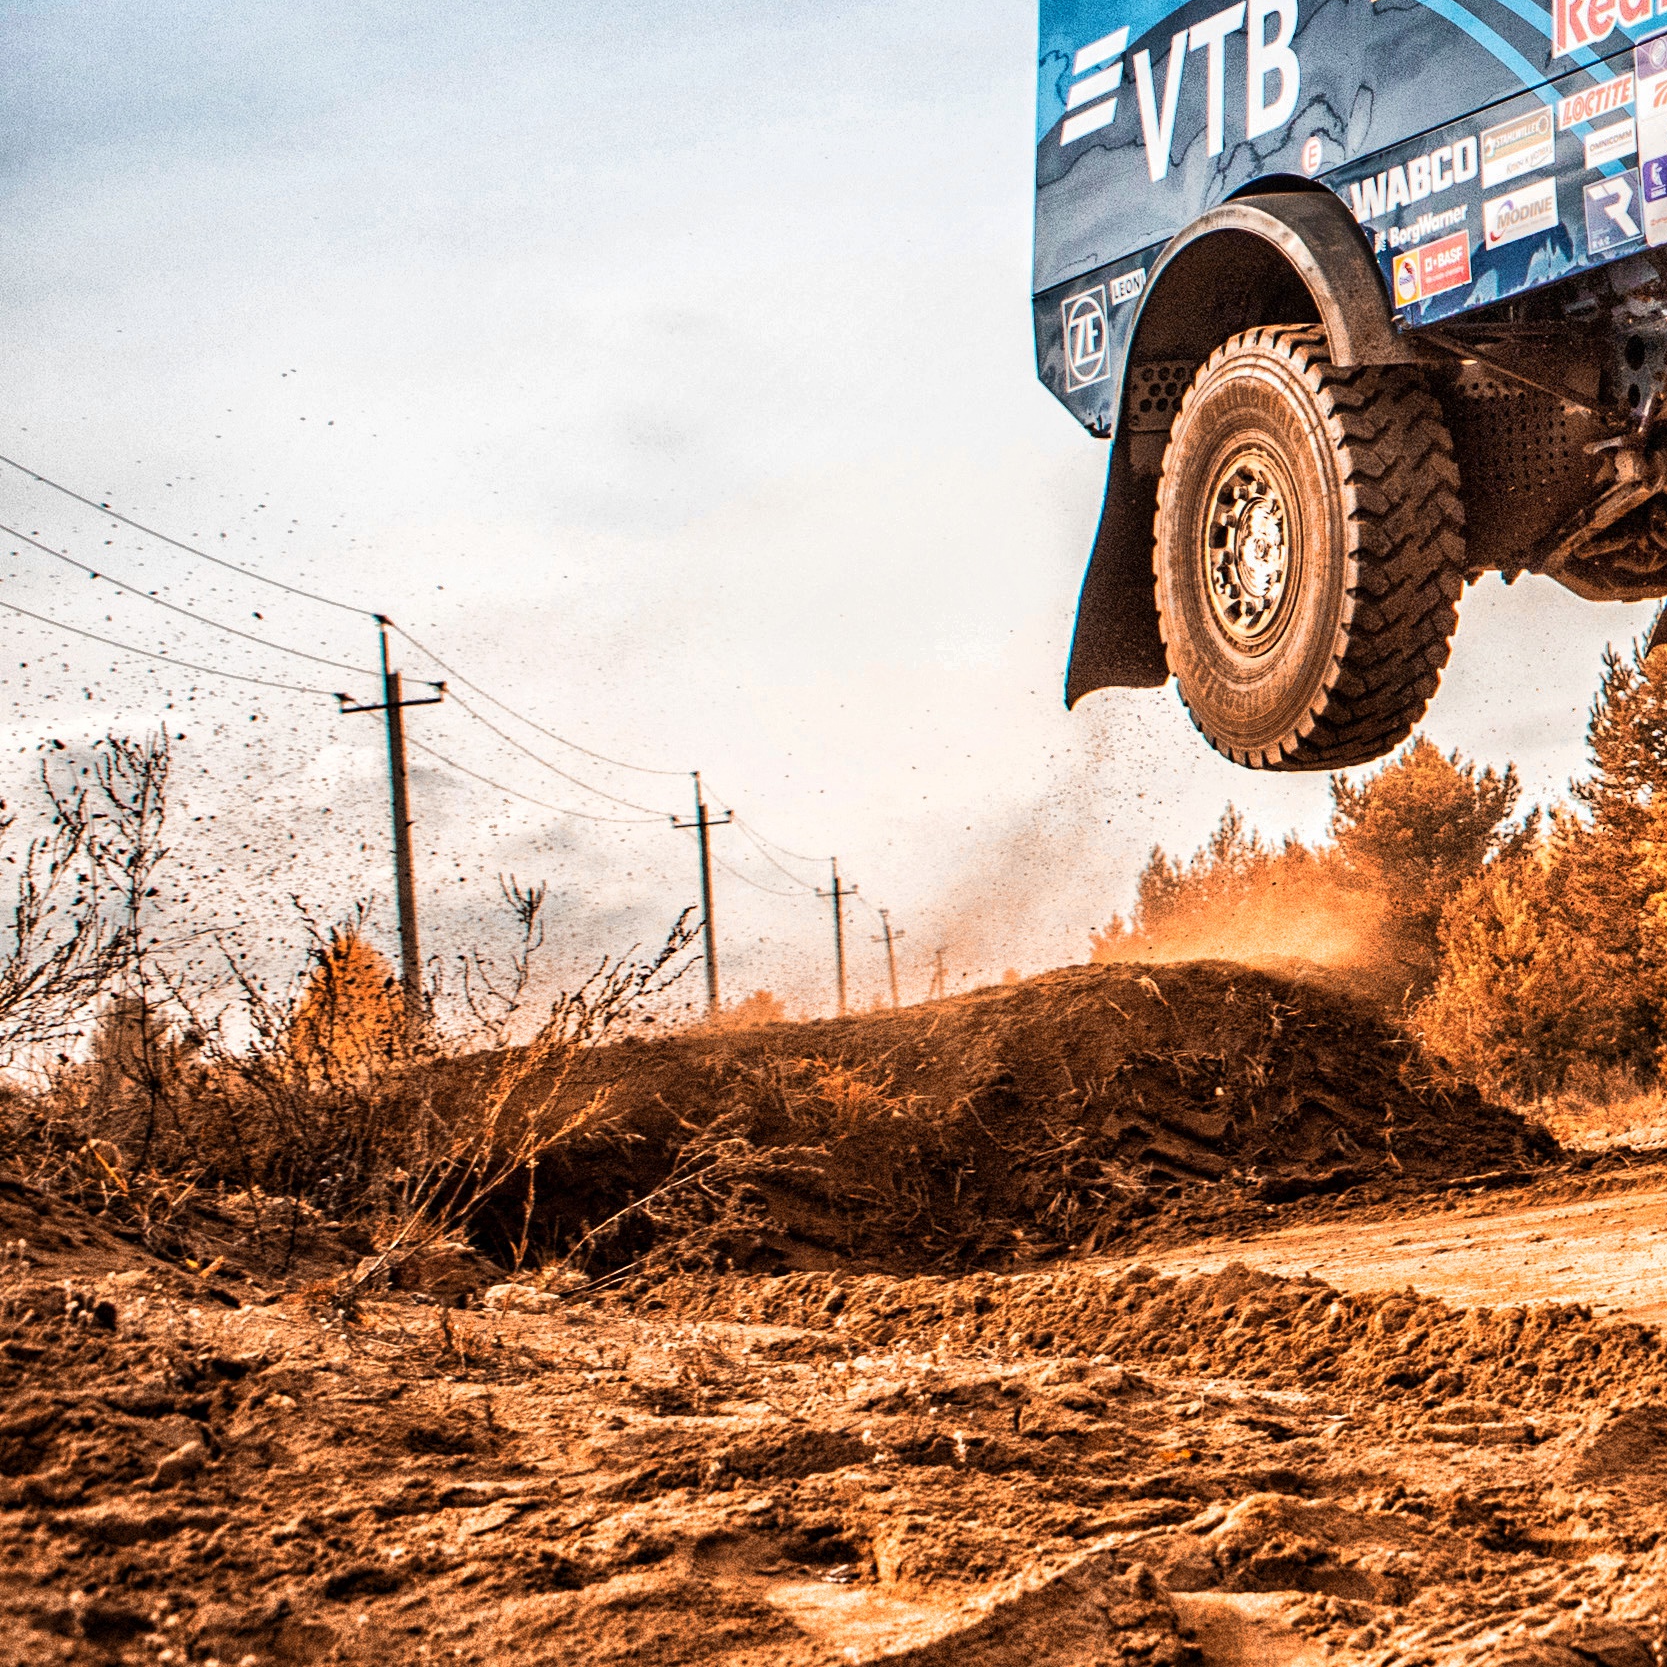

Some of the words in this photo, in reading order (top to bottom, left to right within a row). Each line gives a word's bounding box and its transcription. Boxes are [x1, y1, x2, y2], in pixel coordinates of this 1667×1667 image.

[1562, 76, 1632, 126] LOCTITE
[1350, 135, 1479, 224] WABCO
[1388, 204, 1469, 249] BorgWarner
[1496, 196, 1553, 230] MODINE
[1437, 245, 1464, 268] BASF
